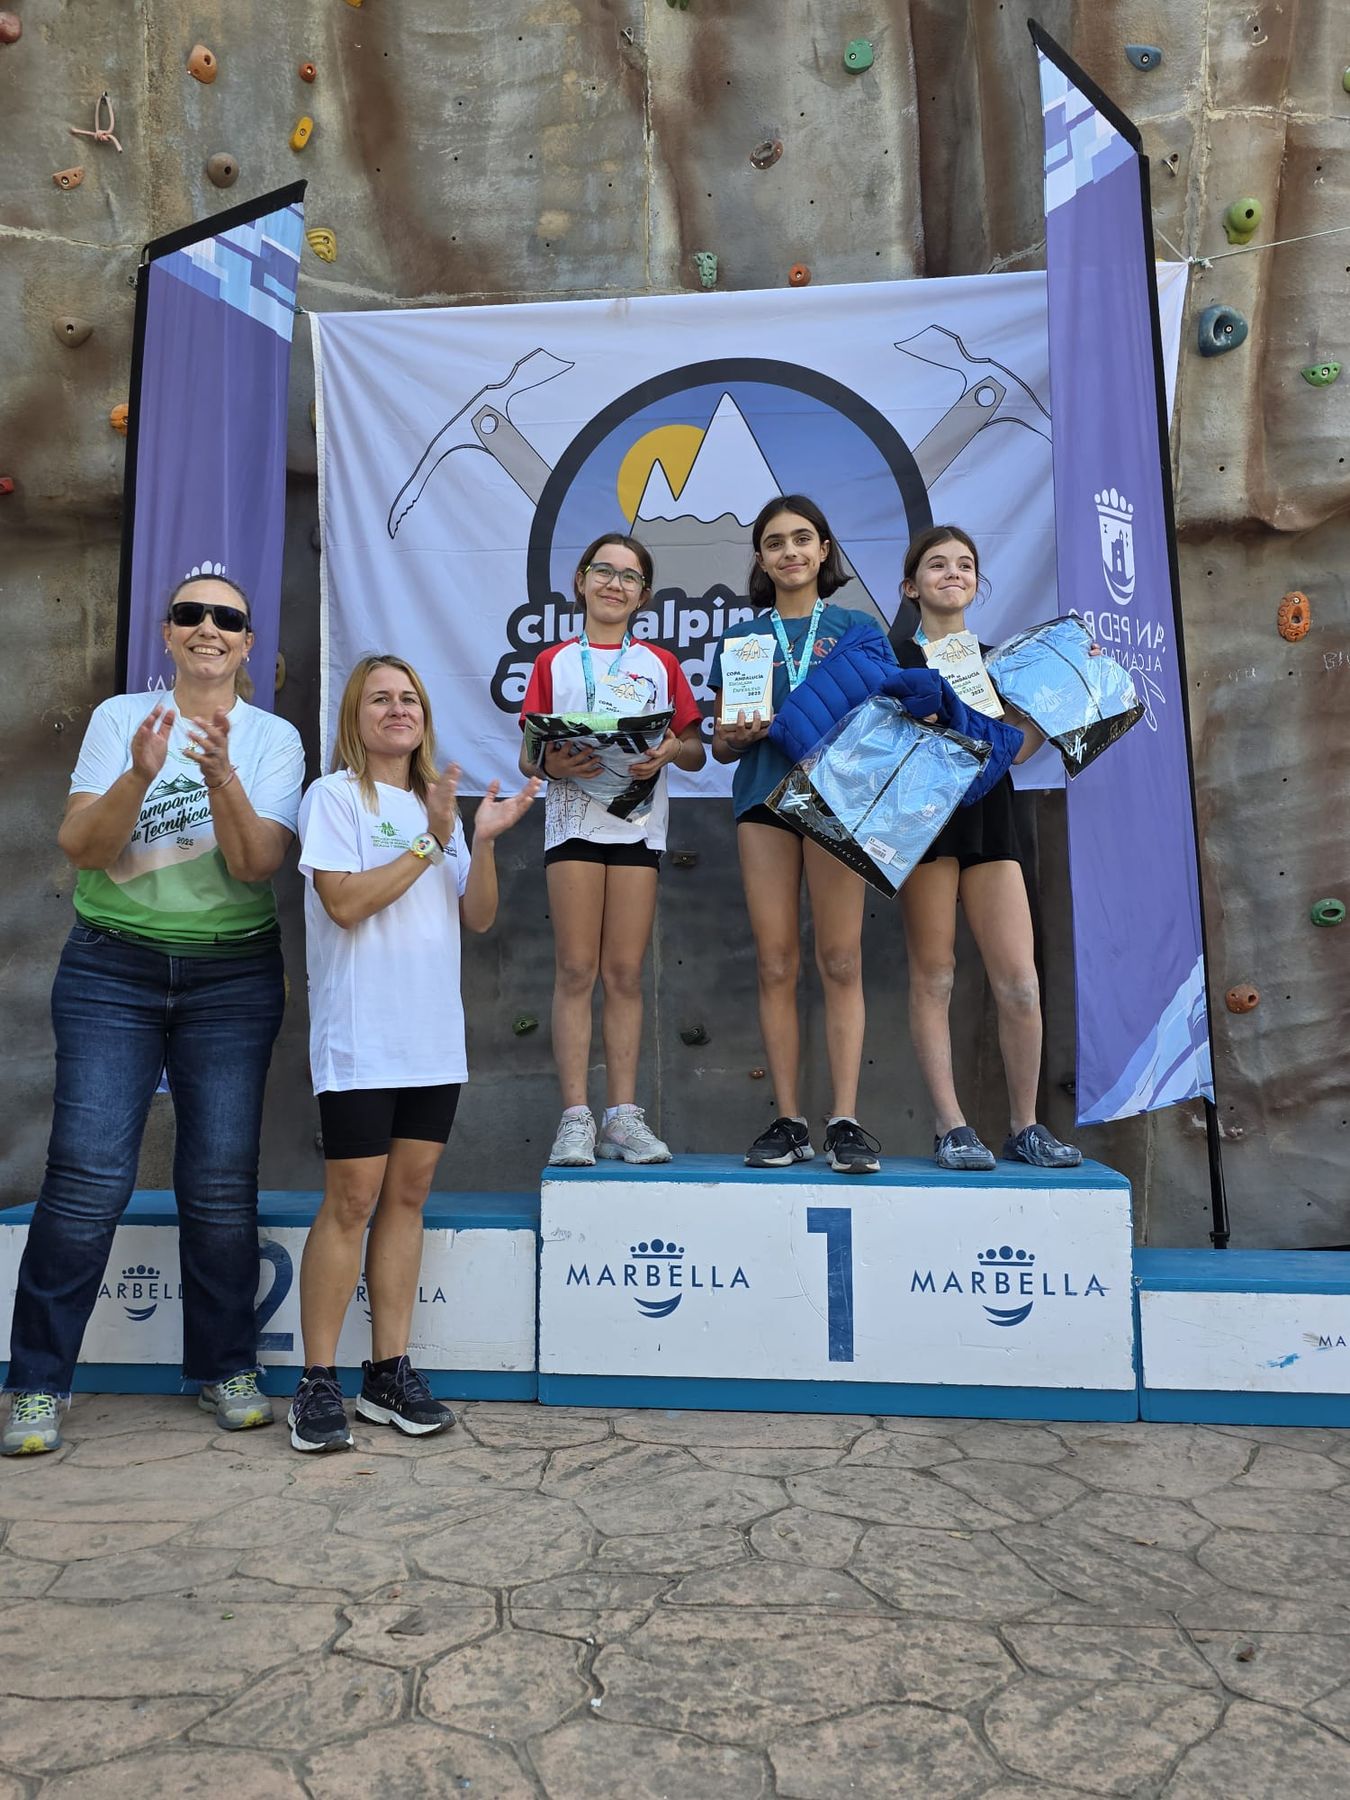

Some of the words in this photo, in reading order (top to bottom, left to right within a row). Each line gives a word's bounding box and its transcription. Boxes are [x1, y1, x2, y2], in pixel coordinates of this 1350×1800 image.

[517, 604, 584, 643] clu
[632, 597, 771, 647] alpin
[140, 789, 208, 821] ampame
[131, 829, 142, 842] de
[141, 807, 211, 843] Tecnifica
[176, 836, 195, 847] 2025
[98, 1282, 183, 1300] ARBELL
[566, 1263, 750, 1289] MARBELLA
[806, 1206, 854, 1363] 1
[910, 1269, 1106, 1298] MARBELLA
[256, 1239, 294, 1352] 2
[1318, 1335, 1347, 1348] MA
